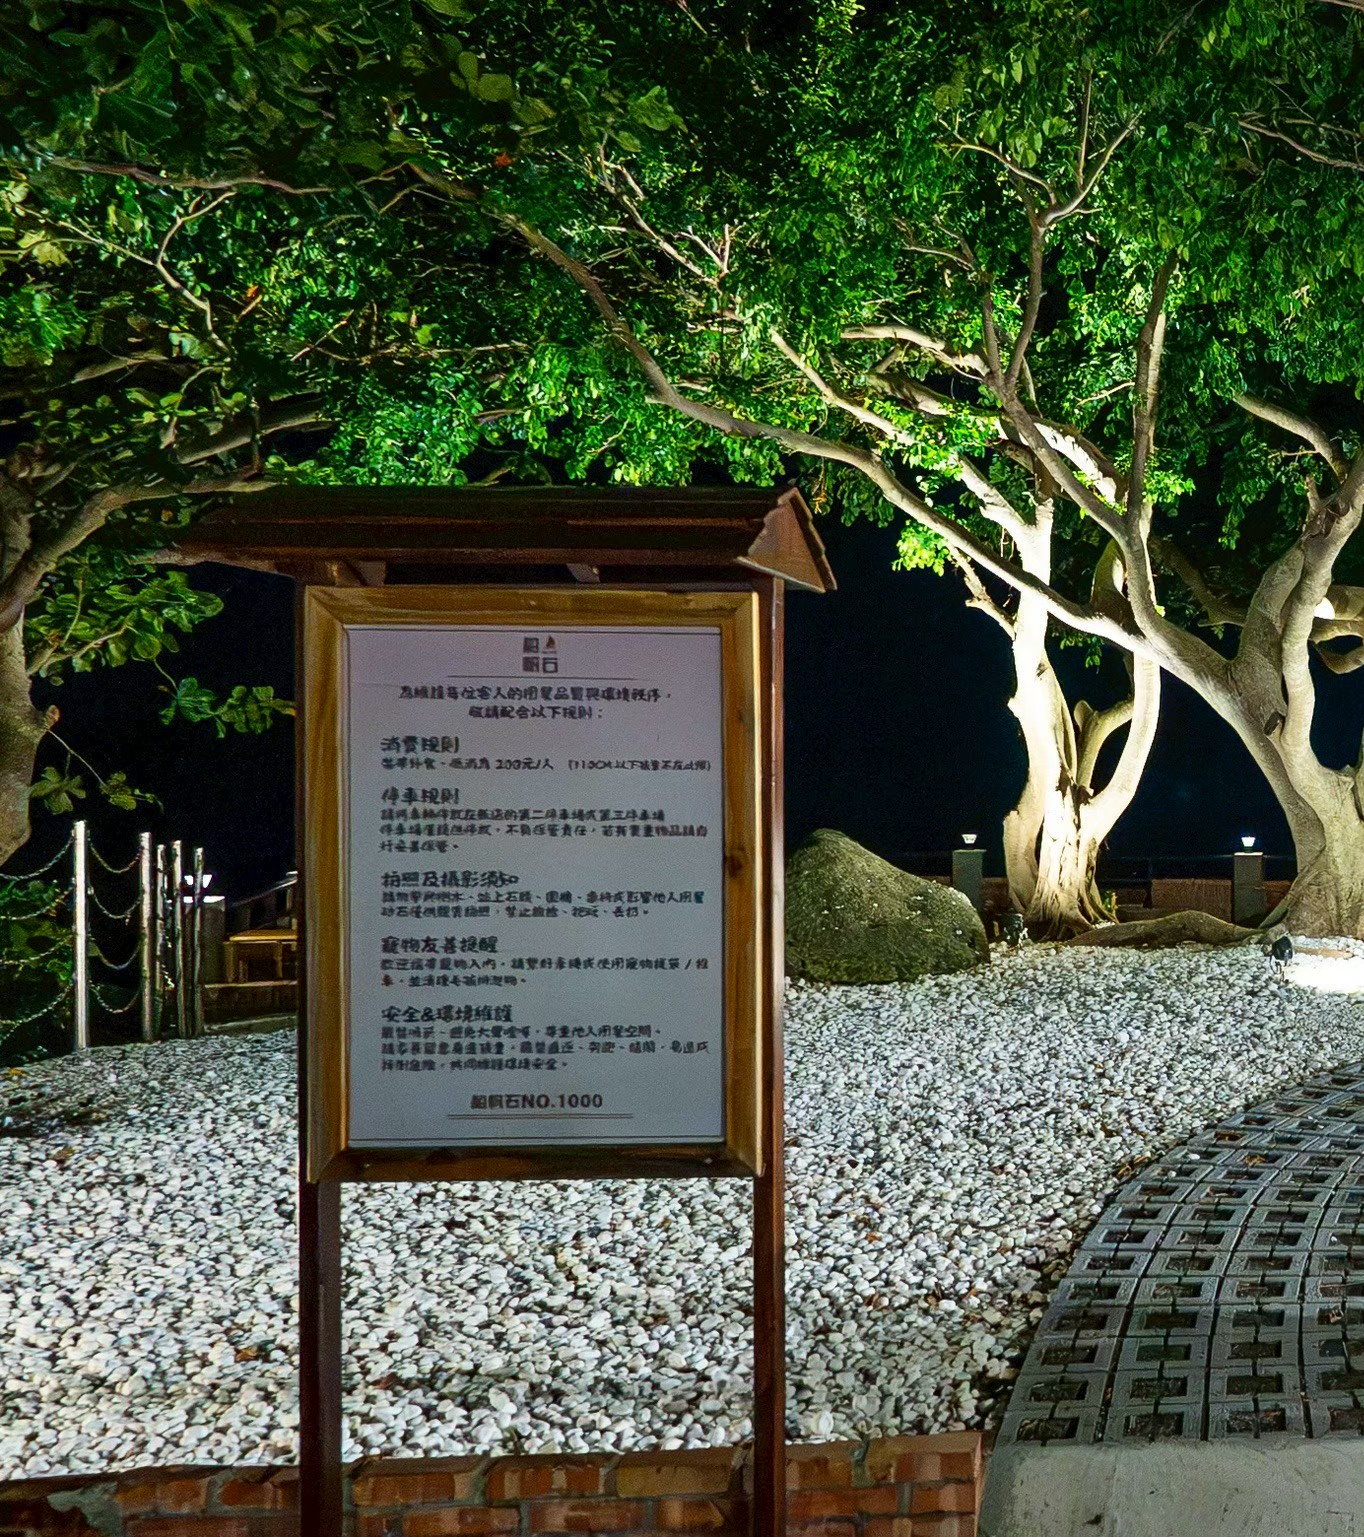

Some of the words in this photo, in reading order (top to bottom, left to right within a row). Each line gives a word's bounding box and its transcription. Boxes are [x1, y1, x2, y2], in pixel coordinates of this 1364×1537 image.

[381, 735, 459, 754] 消費規則
[381, 786, 459, 805] 停車規則
[381, 870, 519, 888] 拍照及攝影須知
[381, 936, 498, 954] 寵物友善提醒
[382, 1004, 512, 1023] 安全&環境維護
